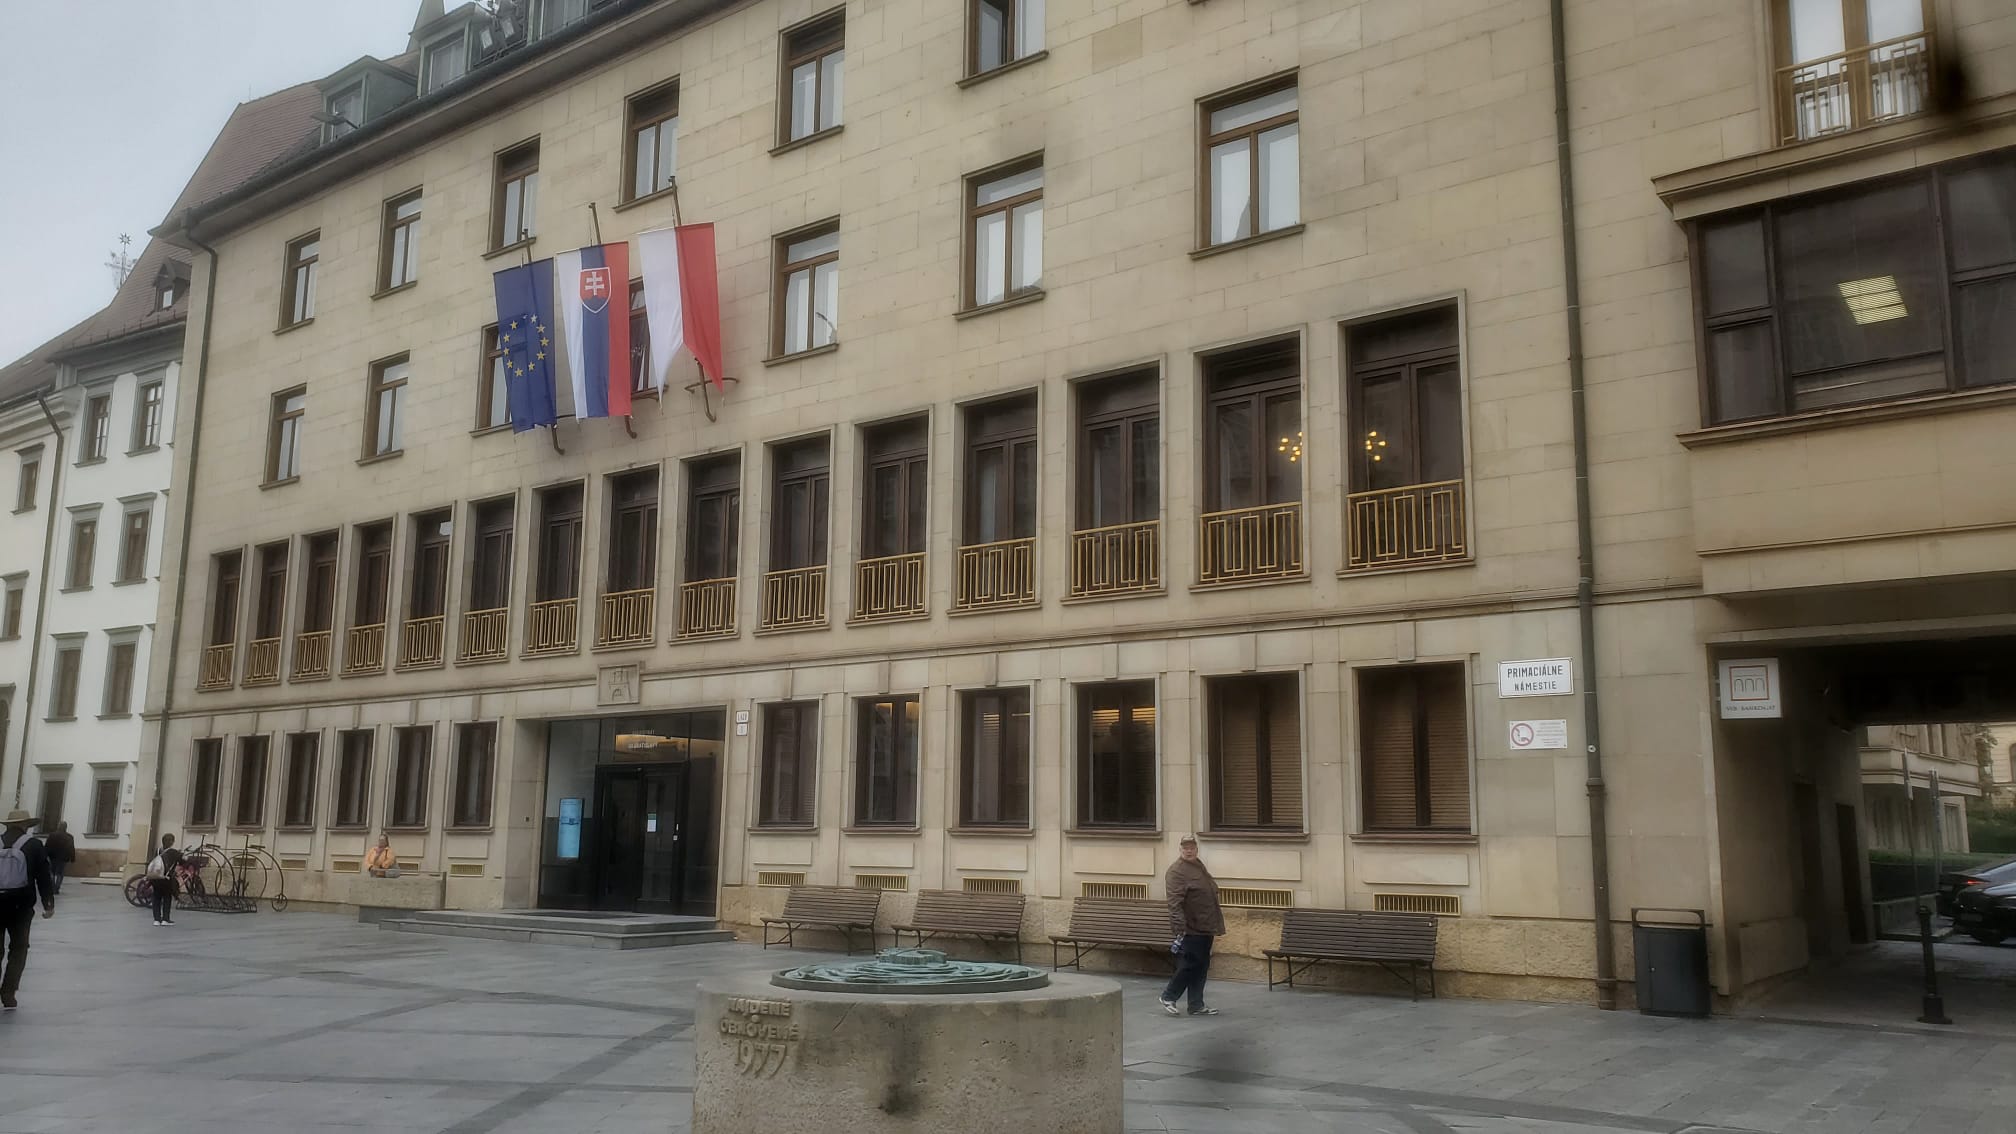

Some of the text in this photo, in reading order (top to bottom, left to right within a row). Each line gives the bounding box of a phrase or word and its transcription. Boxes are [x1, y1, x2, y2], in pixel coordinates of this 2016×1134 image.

[1507, 665, 1563, 678] PRIMACIÁLNE
[1514, 681, 1557, 691] NÁMESTIE
[735, 1040, 786, 1079] 1977
